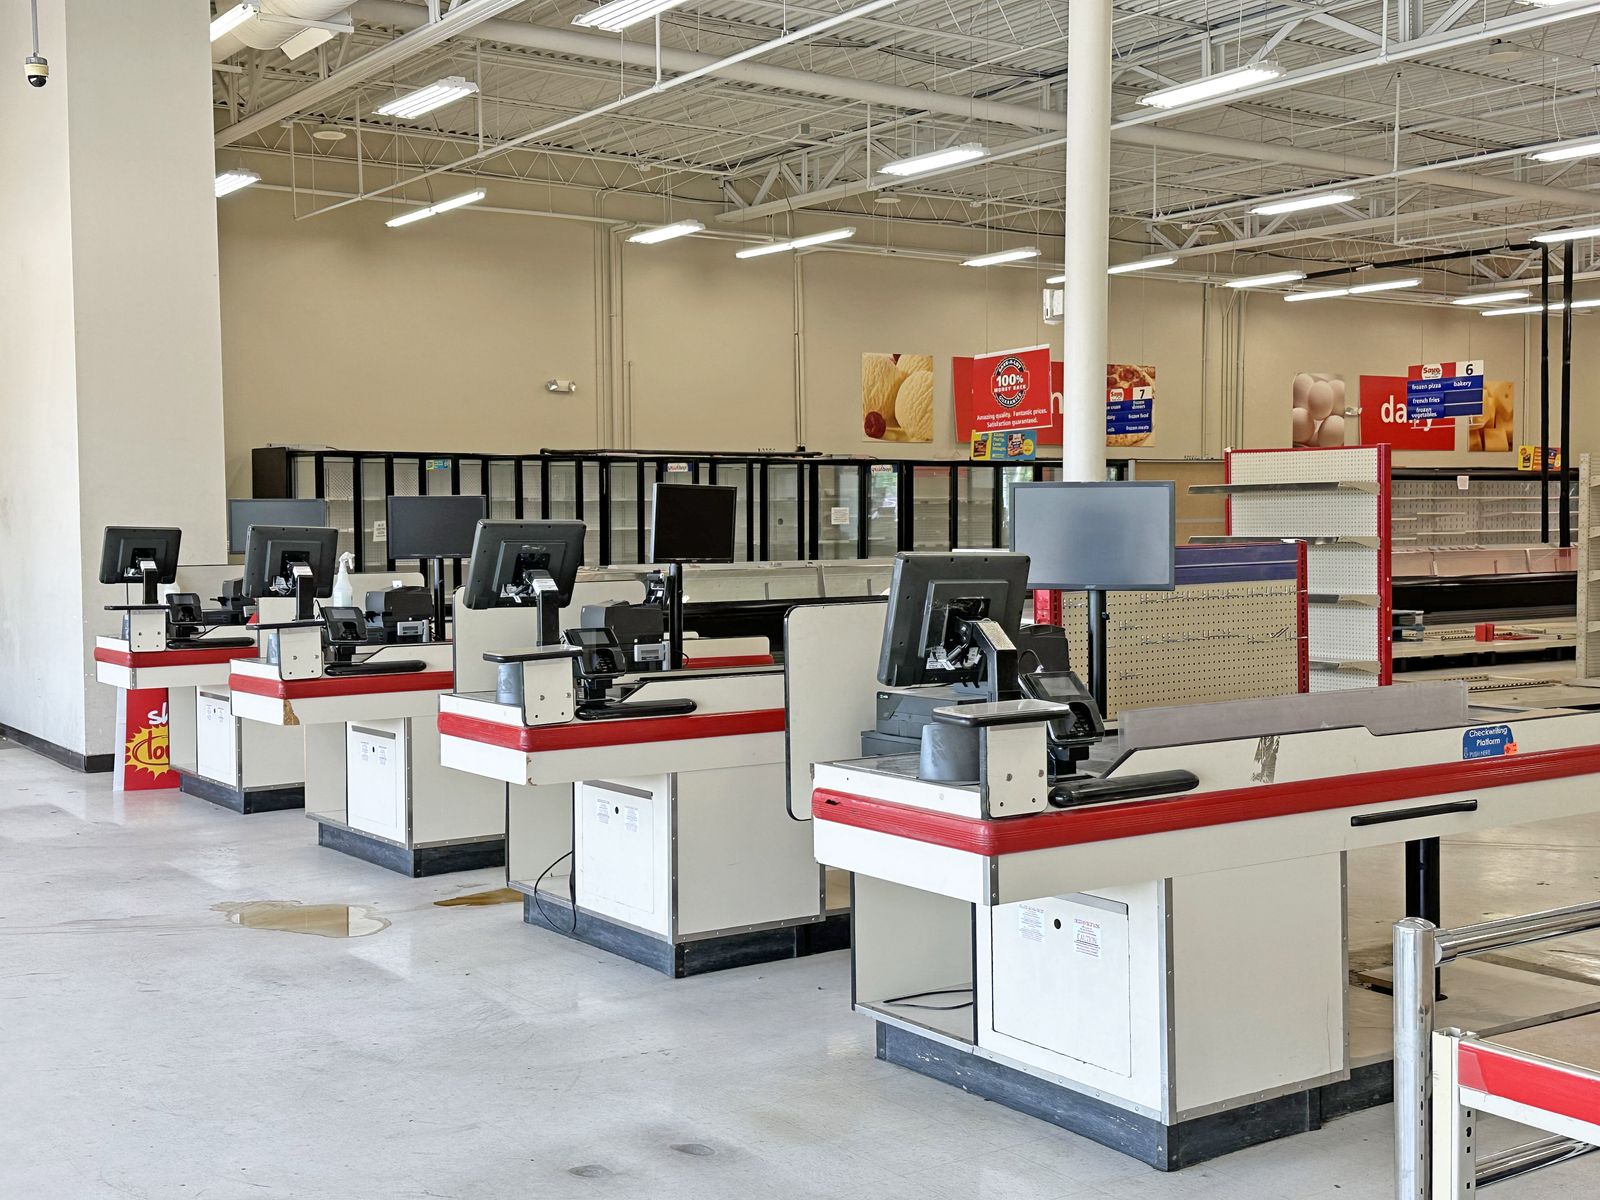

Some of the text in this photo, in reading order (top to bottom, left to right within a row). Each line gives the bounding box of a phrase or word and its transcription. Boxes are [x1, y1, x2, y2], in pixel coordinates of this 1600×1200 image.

[1466, 364, 1474, 375] 6
[996, 374, 1024, 386] 100%
[1140, 390, 1145, 398] 7
[1469, 728, 1508, 737] Checkwriting
[1476, 738, 1500, 746] Platform
